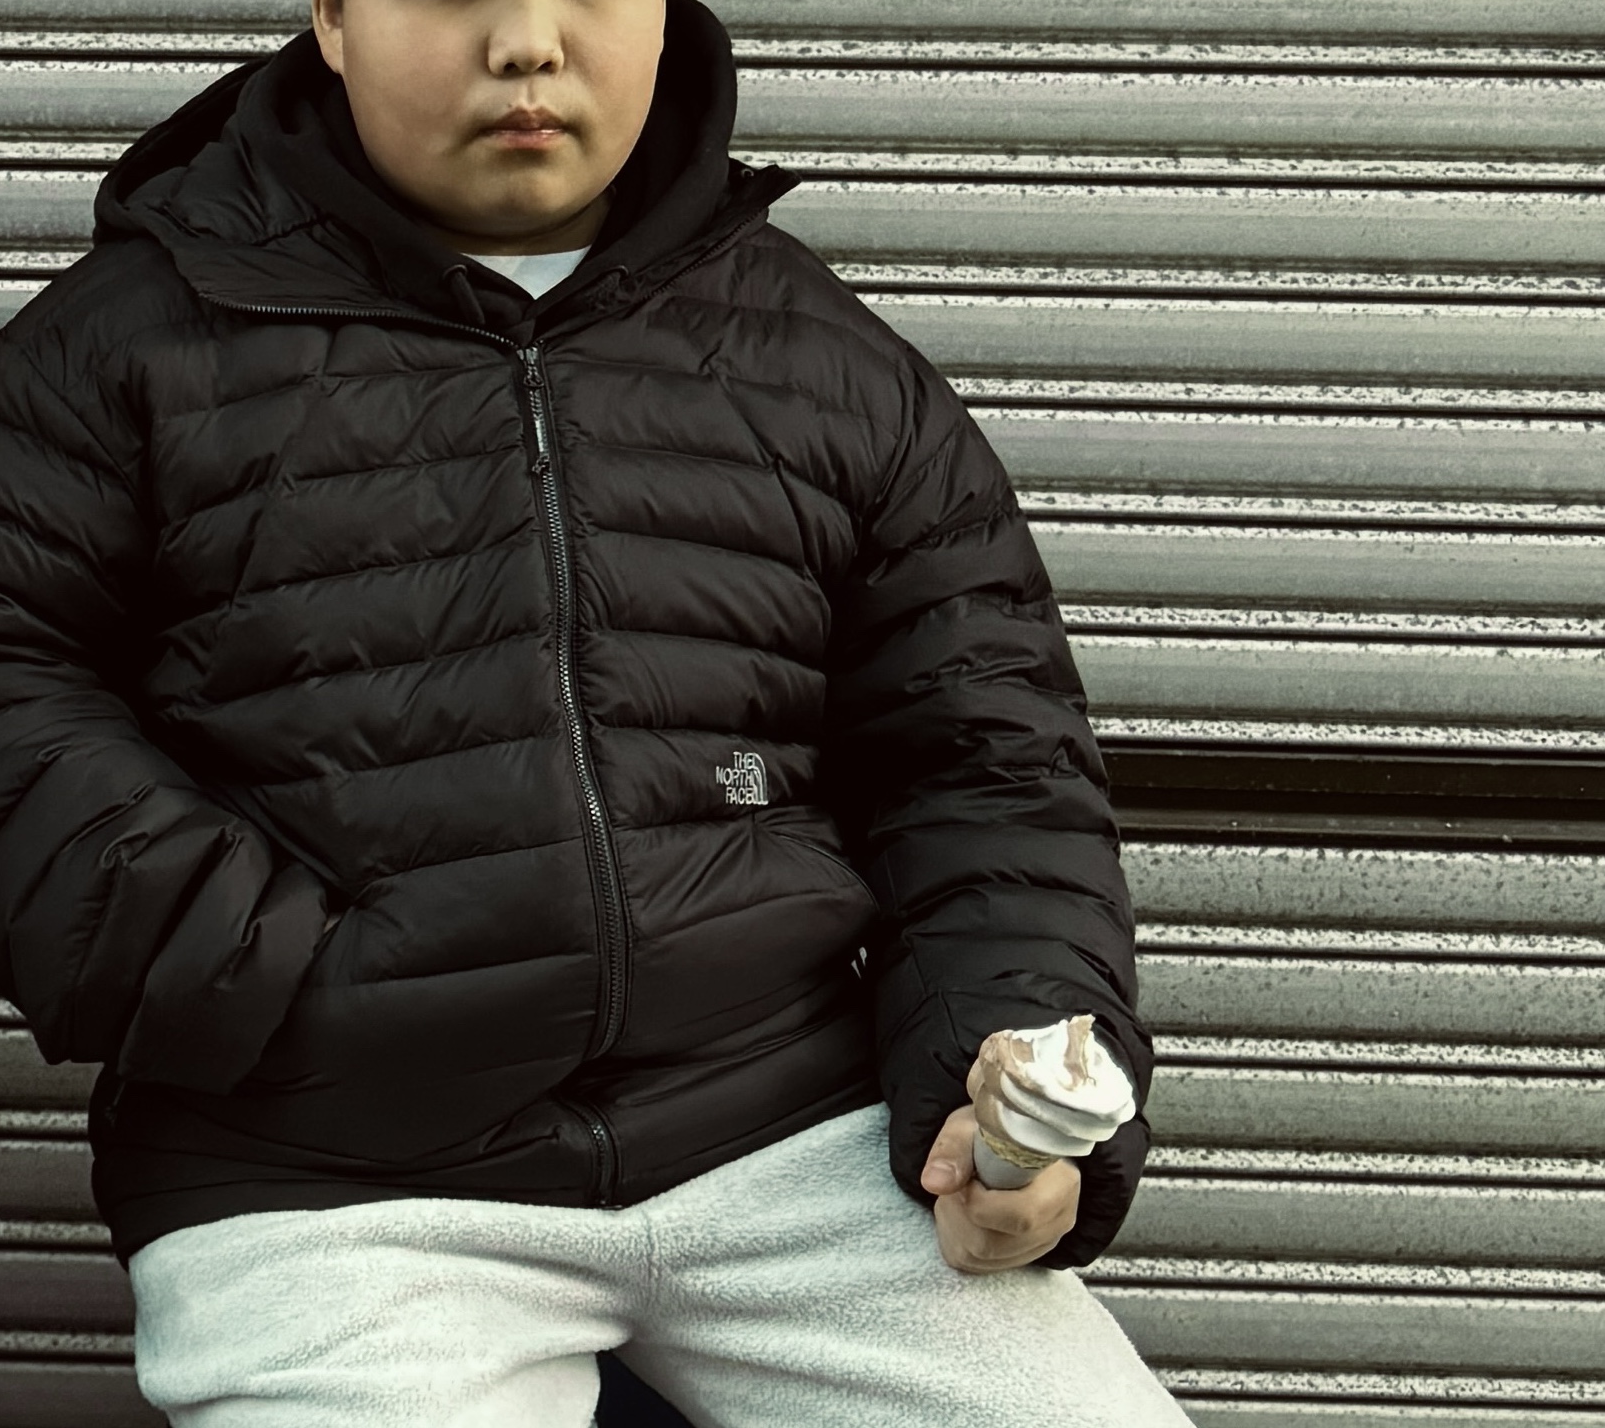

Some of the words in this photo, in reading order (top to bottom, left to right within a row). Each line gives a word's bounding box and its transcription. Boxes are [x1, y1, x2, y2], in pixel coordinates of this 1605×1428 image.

[732, 751, 755, 770] THE
[715, 765, 755, 787] NORTH
[725, 786, 756, 805] FACE
